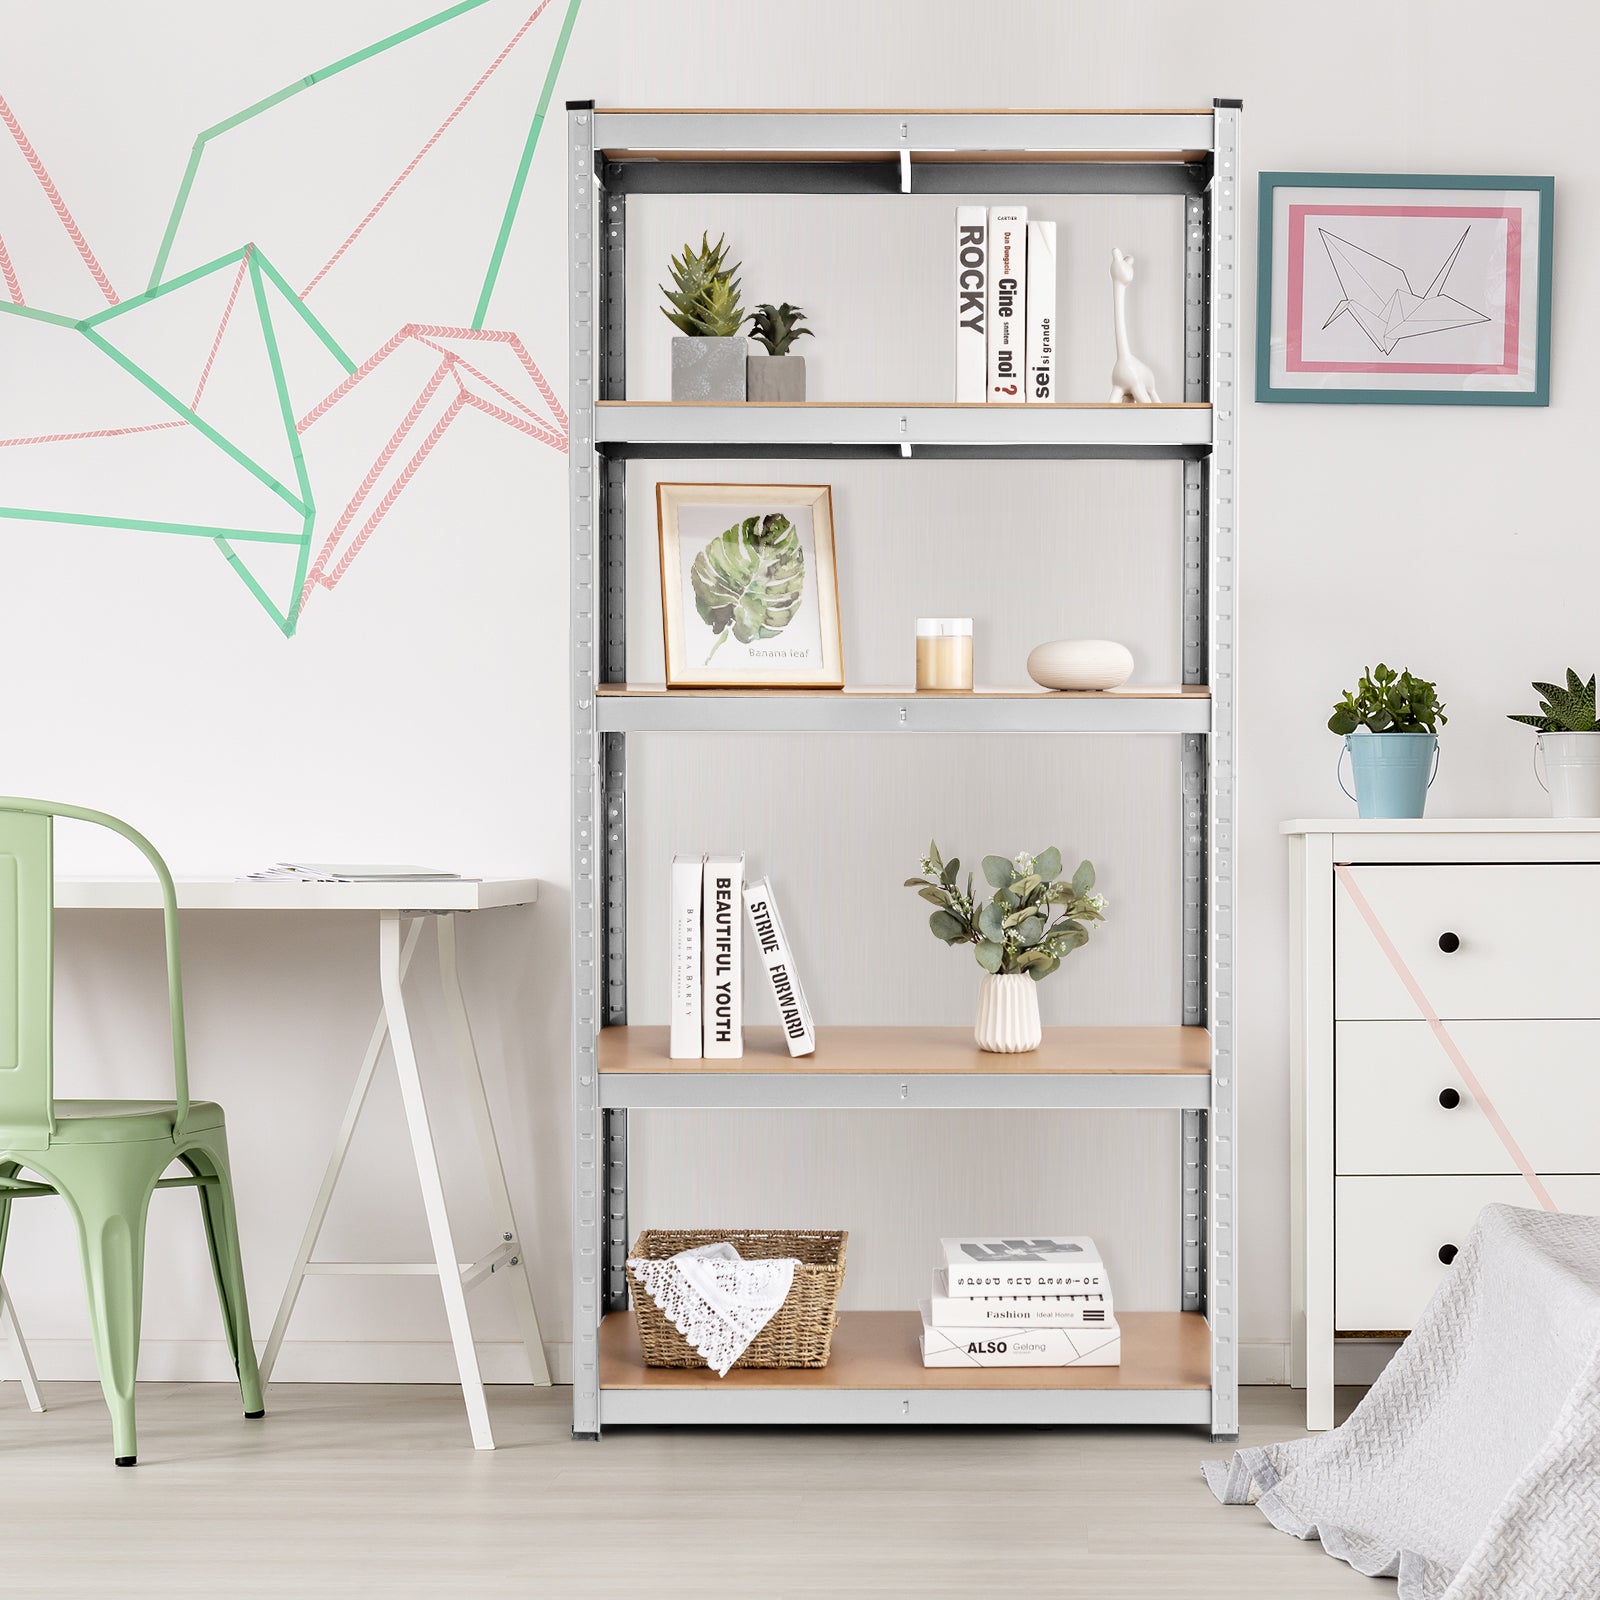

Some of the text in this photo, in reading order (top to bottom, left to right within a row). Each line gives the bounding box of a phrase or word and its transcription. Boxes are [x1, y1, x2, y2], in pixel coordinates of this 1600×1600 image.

[1003, 245, 1011, 275] Dungaciu
[960, 226, 984, 335] ROCKY
[998, 278, 1018, 318] Cine
[1032, 318, 1052, 399] sei si grande
[749, 648, 809, 658] Banana leaf
[716, 878, 731, 1042] BEAUTIFUL YOUTH
[750, 901, 805, 1039] STRIVE FORWARD
[958, 1277, 1099, 1286] speed and passion
[986, 1310, 1031, 1319] Fashion
[967, 1342, 1047, 1354] ALSO Gelang
